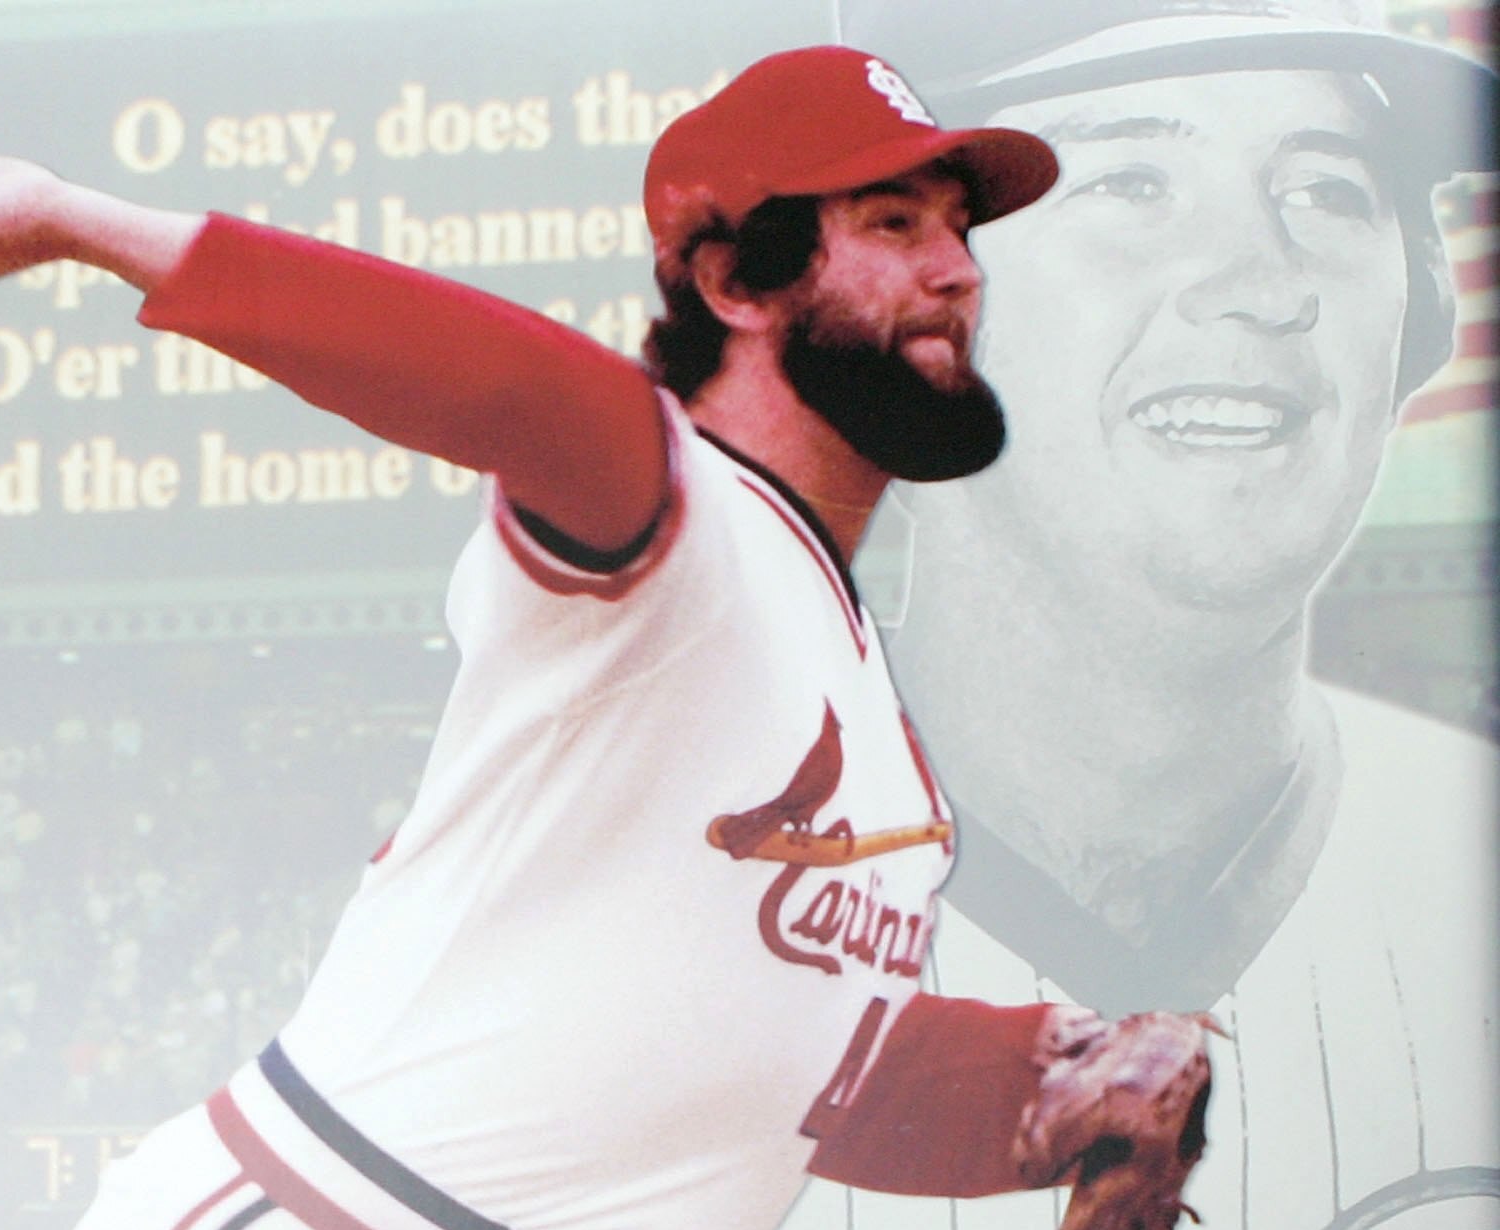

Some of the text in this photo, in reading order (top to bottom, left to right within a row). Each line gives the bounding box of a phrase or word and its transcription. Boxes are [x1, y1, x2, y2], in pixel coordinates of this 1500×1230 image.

[113, 68, 732, 184] O say, does tha
[59, 440, 183, 513] the
[199, 433, 411, 507] home
